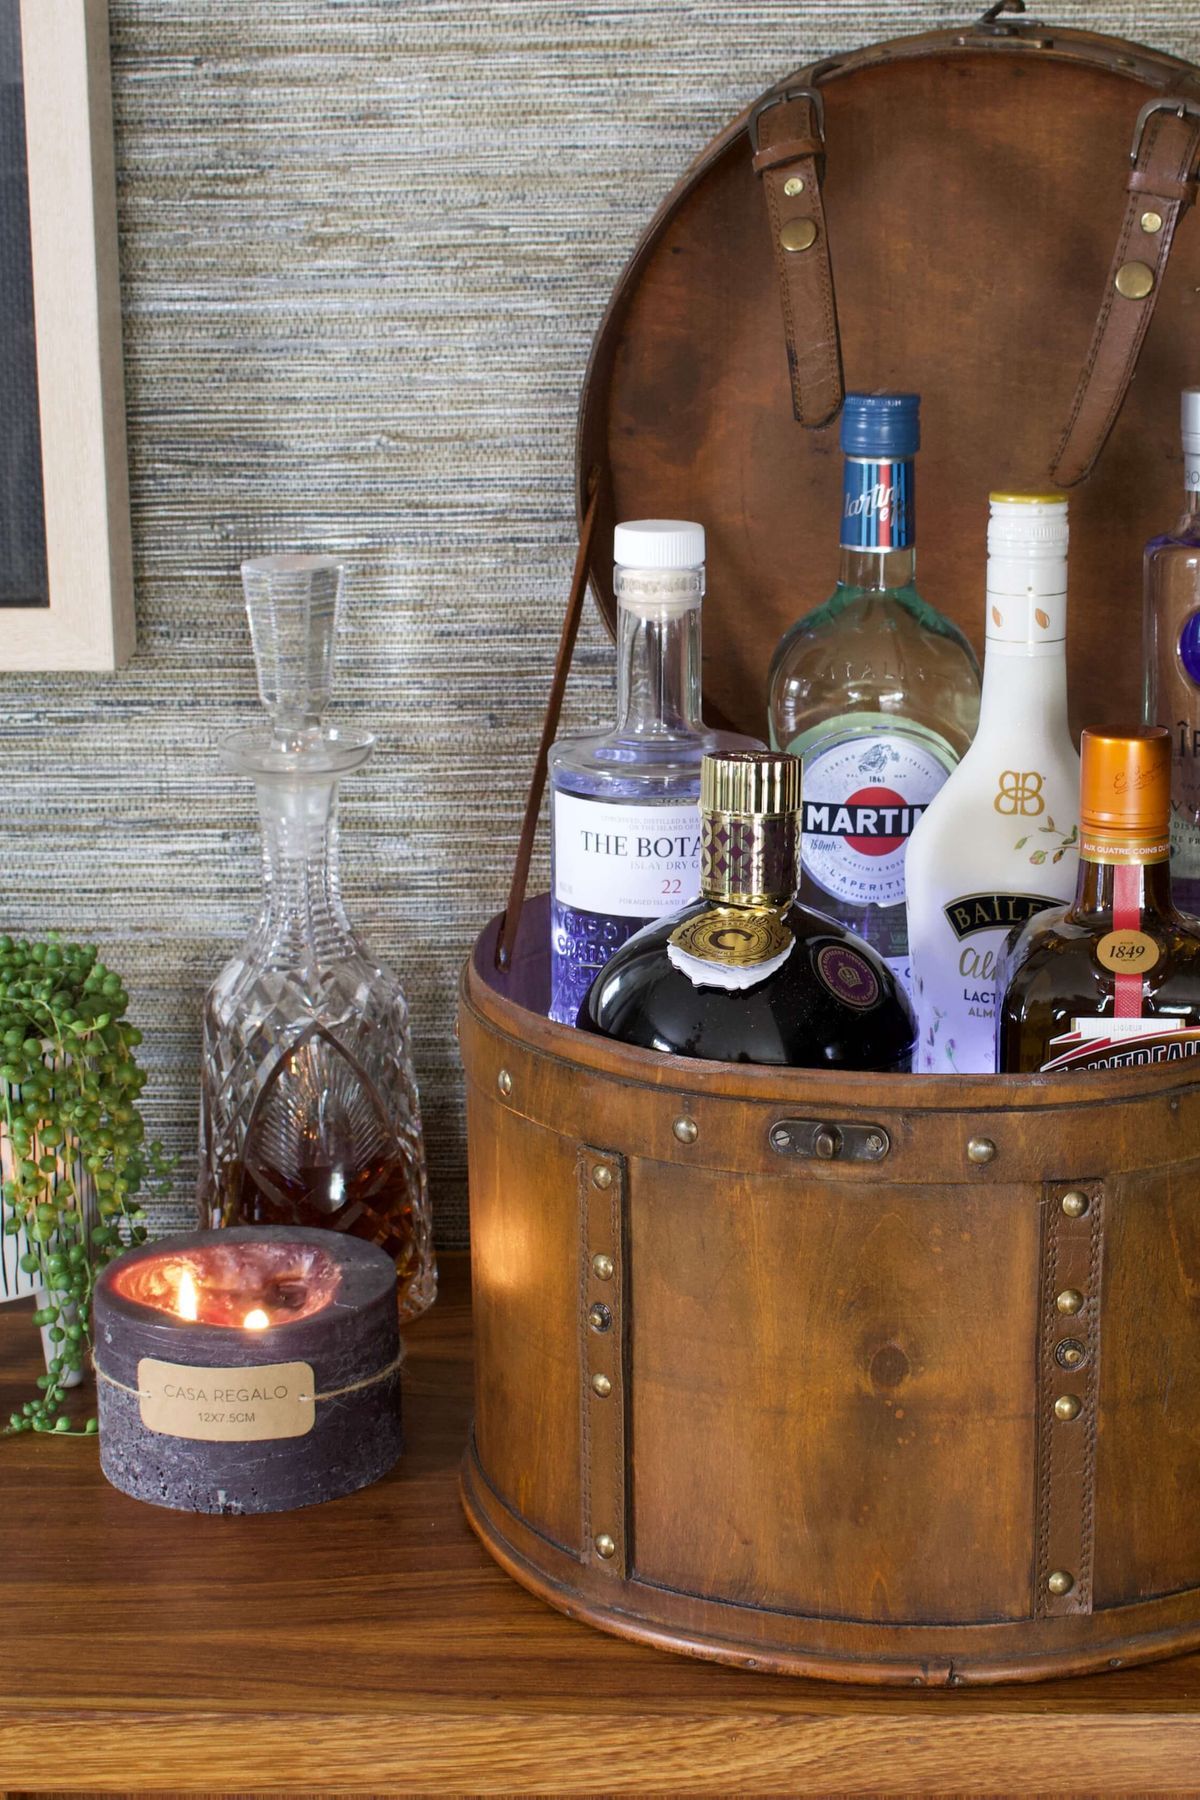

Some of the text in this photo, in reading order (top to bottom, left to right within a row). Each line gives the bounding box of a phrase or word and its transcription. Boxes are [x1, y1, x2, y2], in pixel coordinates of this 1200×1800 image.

[580, 830, 628, 857] THE
[1132, 846, 1158, 855] COINS
[630, 861, 662, 871] ISLAY
[666, 861, 688, 871] DRY
[661, 879, 682, 894] 22
[1110, 945, 1146, 959] 1849
[163, 1384, 288, 1403] CASA REGALO
[198, 1412, 256, 1424] 12X7.5CM
